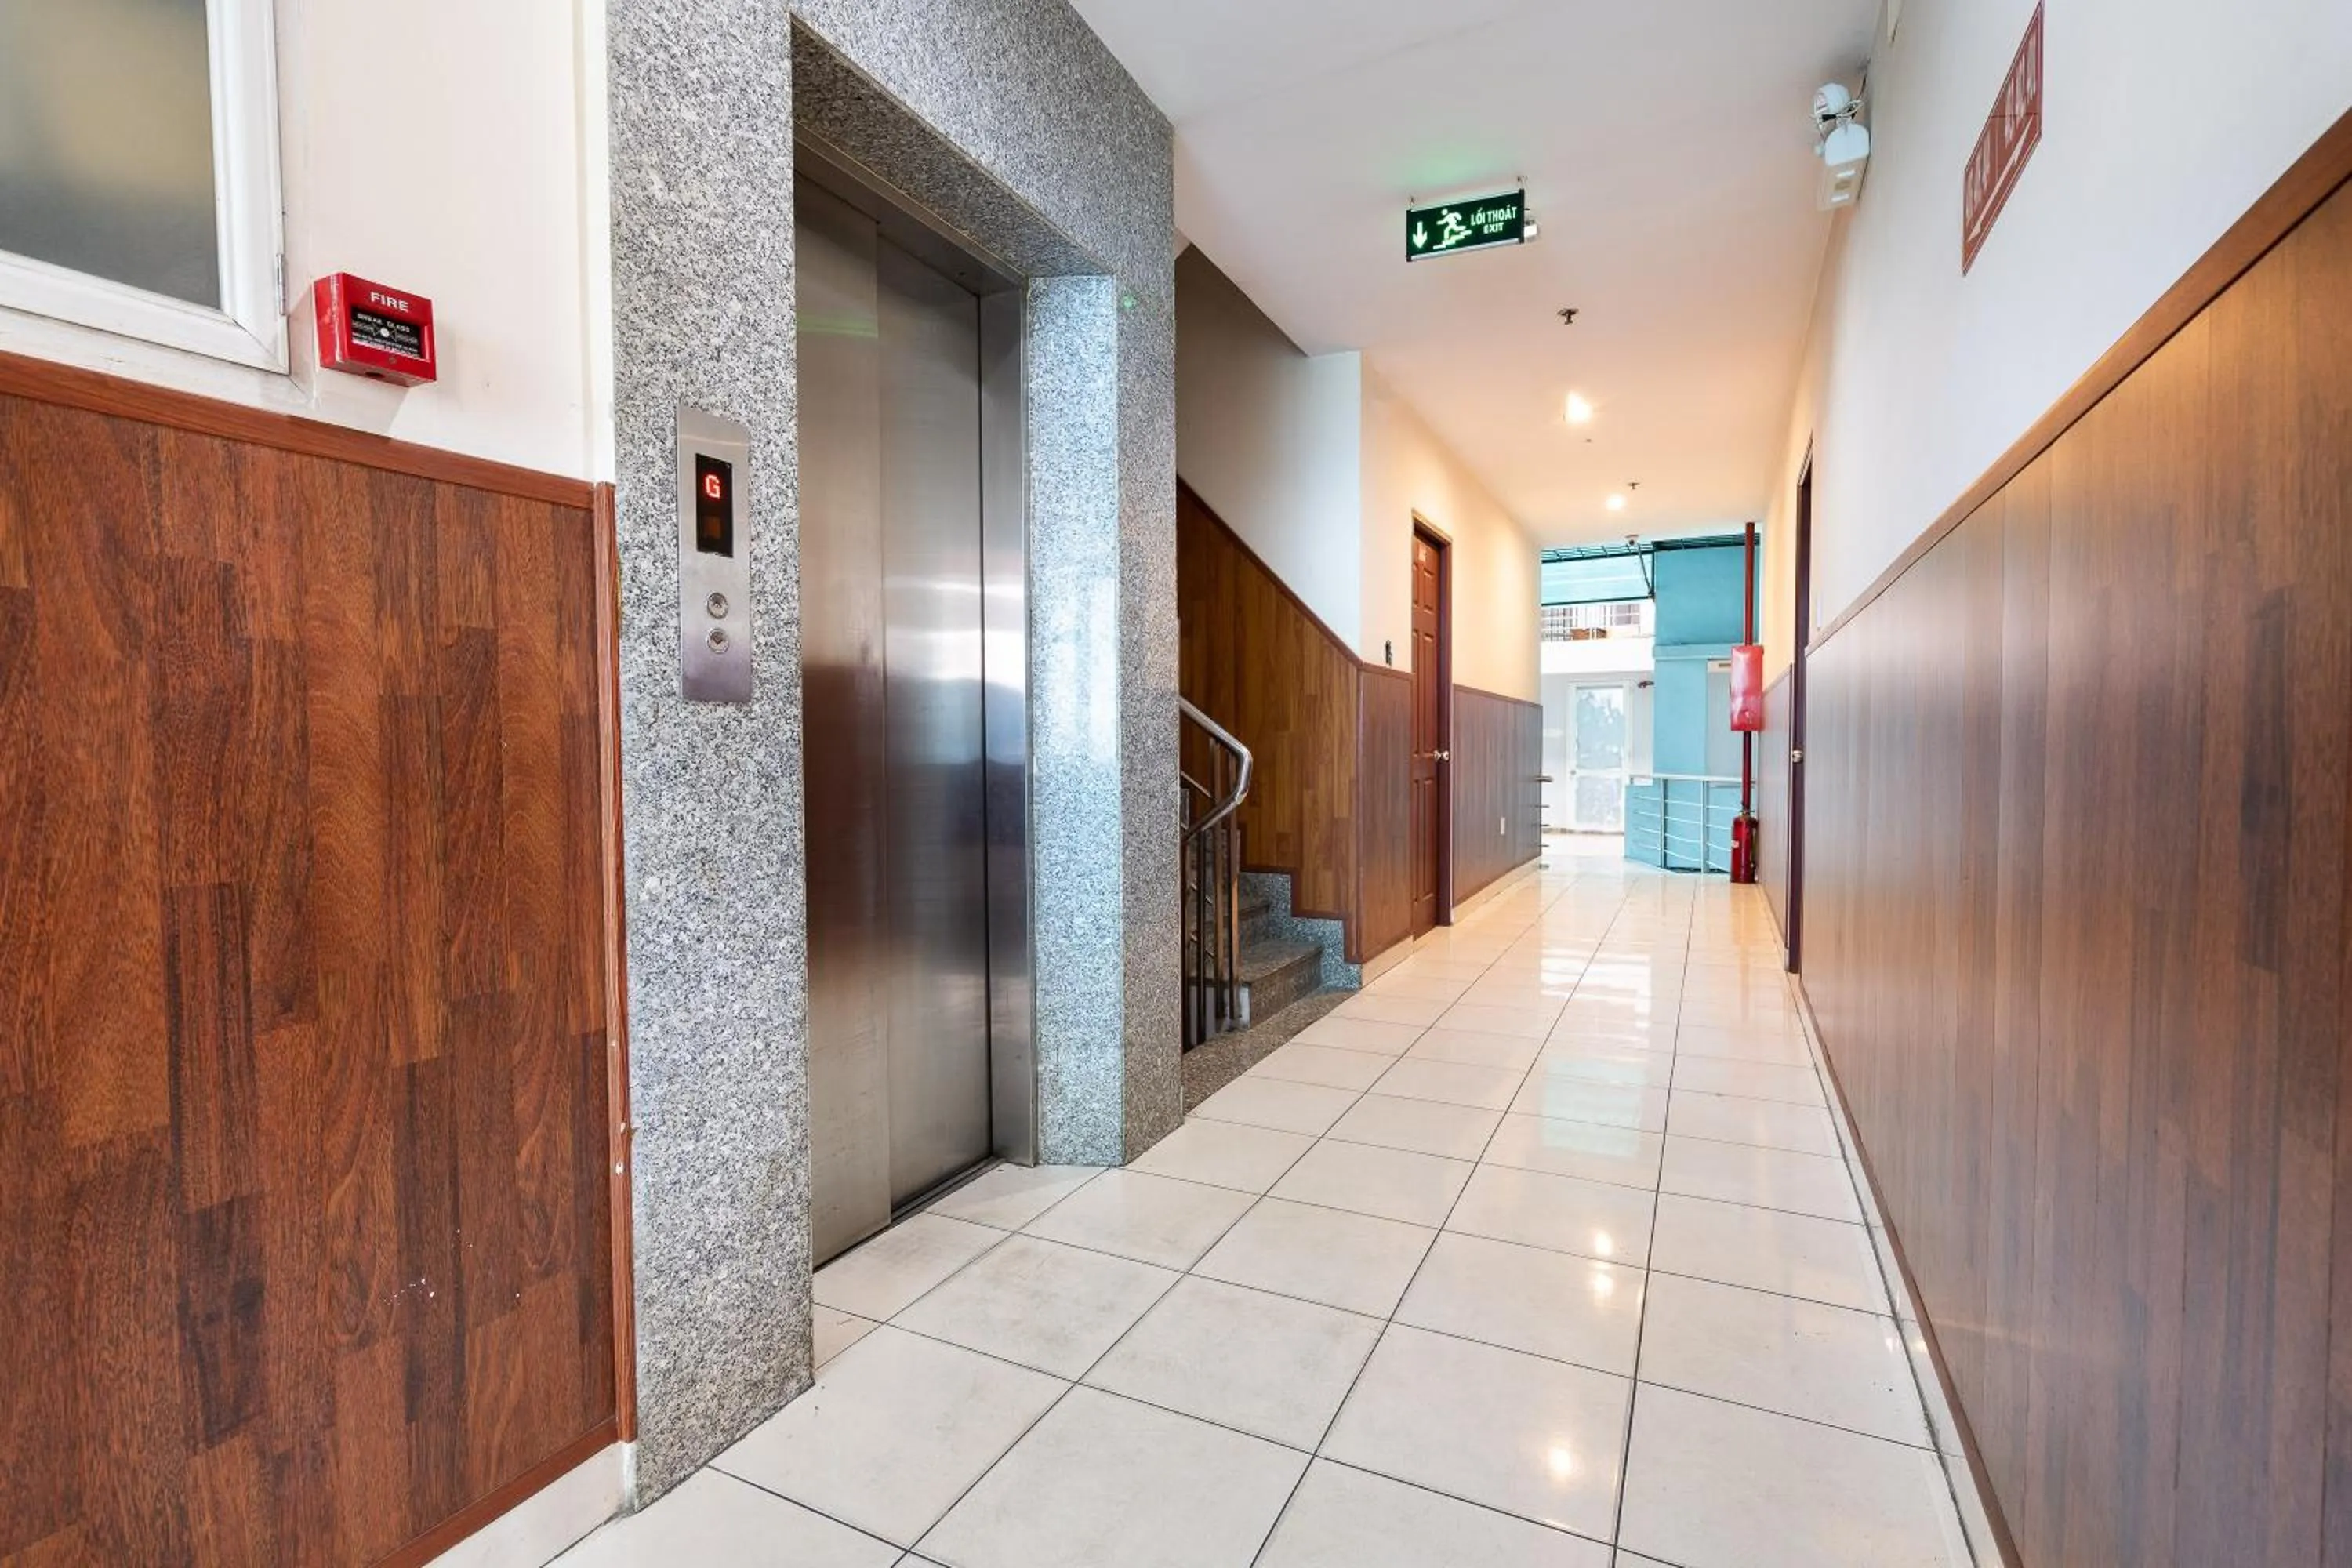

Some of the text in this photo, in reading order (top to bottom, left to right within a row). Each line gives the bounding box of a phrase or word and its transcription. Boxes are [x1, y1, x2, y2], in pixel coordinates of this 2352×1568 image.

[1470, 204, 1517, 226] LỐI THOÁT
[1483, 222, 1504, 234] EXIT
[370, 291, 408, 313] FIRE
[705, 474, 721, 499] G
